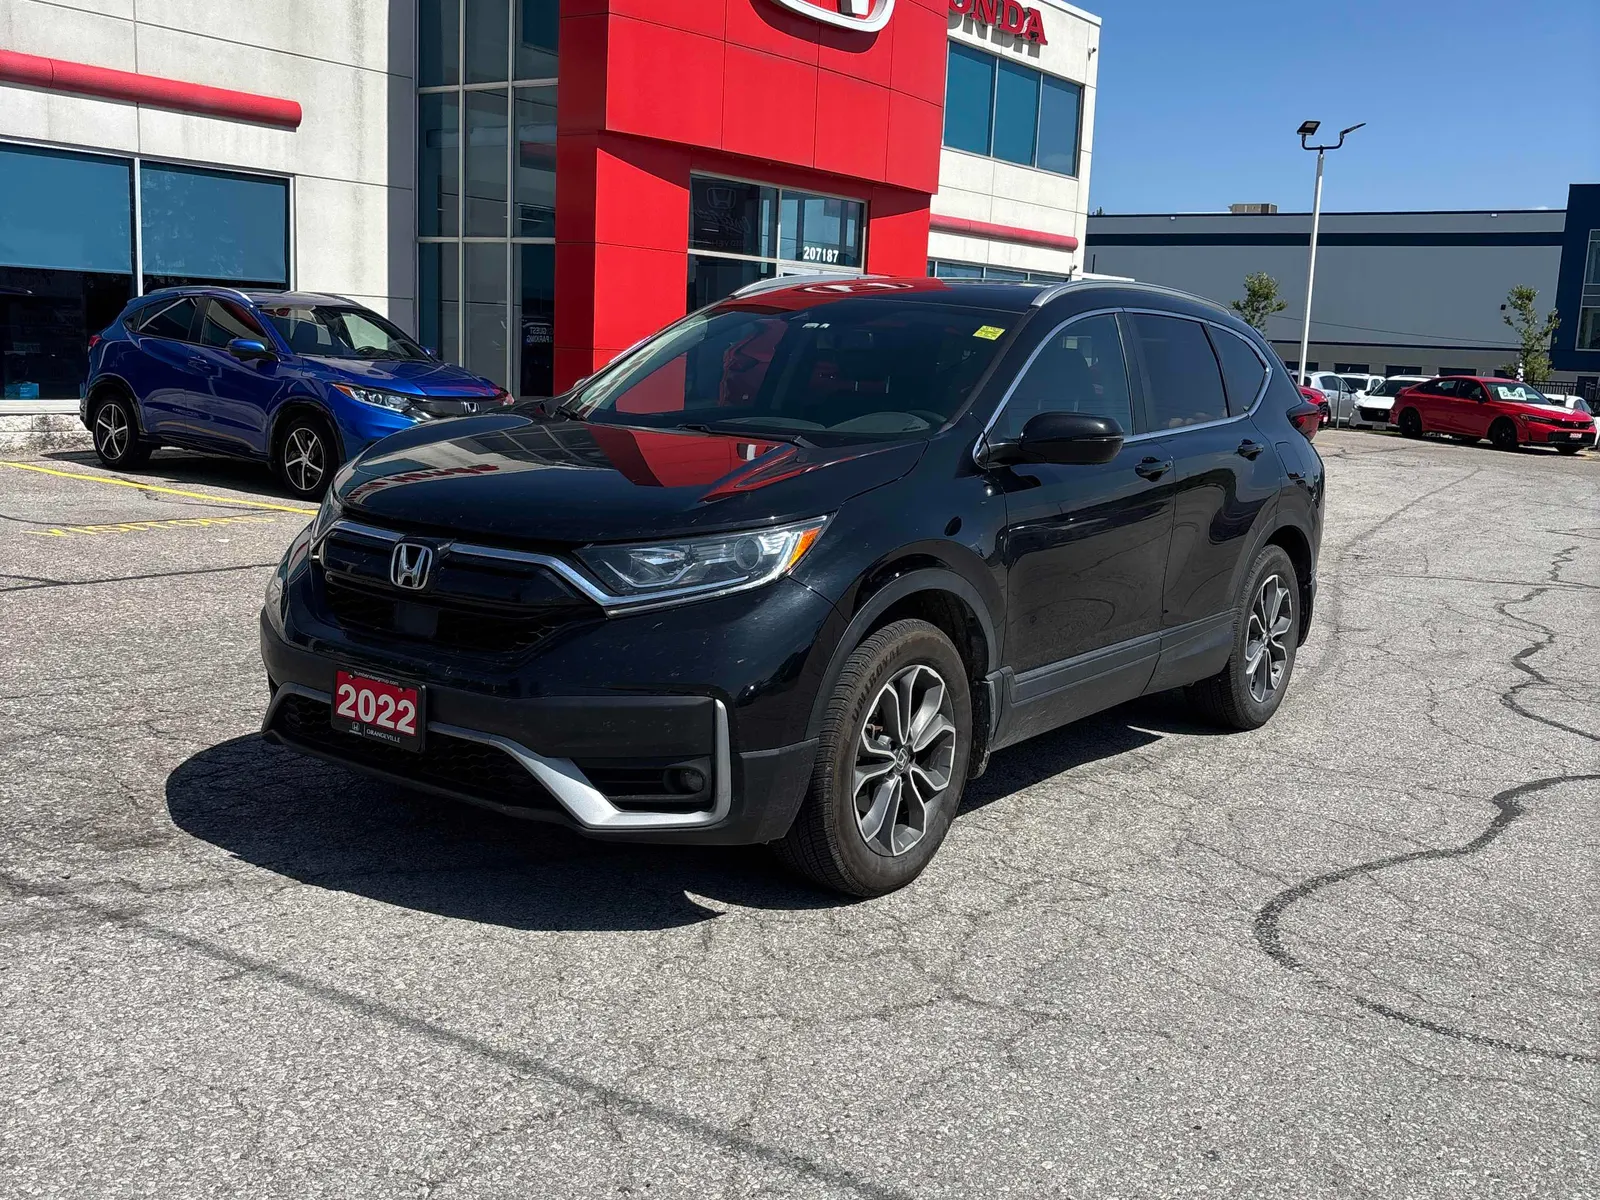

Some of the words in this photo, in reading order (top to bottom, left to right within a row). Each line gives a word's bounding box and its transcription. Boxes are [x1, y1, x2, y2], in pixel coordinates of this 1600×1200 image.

[803, 246, 839, 263] 207187
[851, 645, 902, 723] UNIROYAL
[337, 683, 416, 735] 2022
[366, 728, 401, 744] ORANGEVILLE
